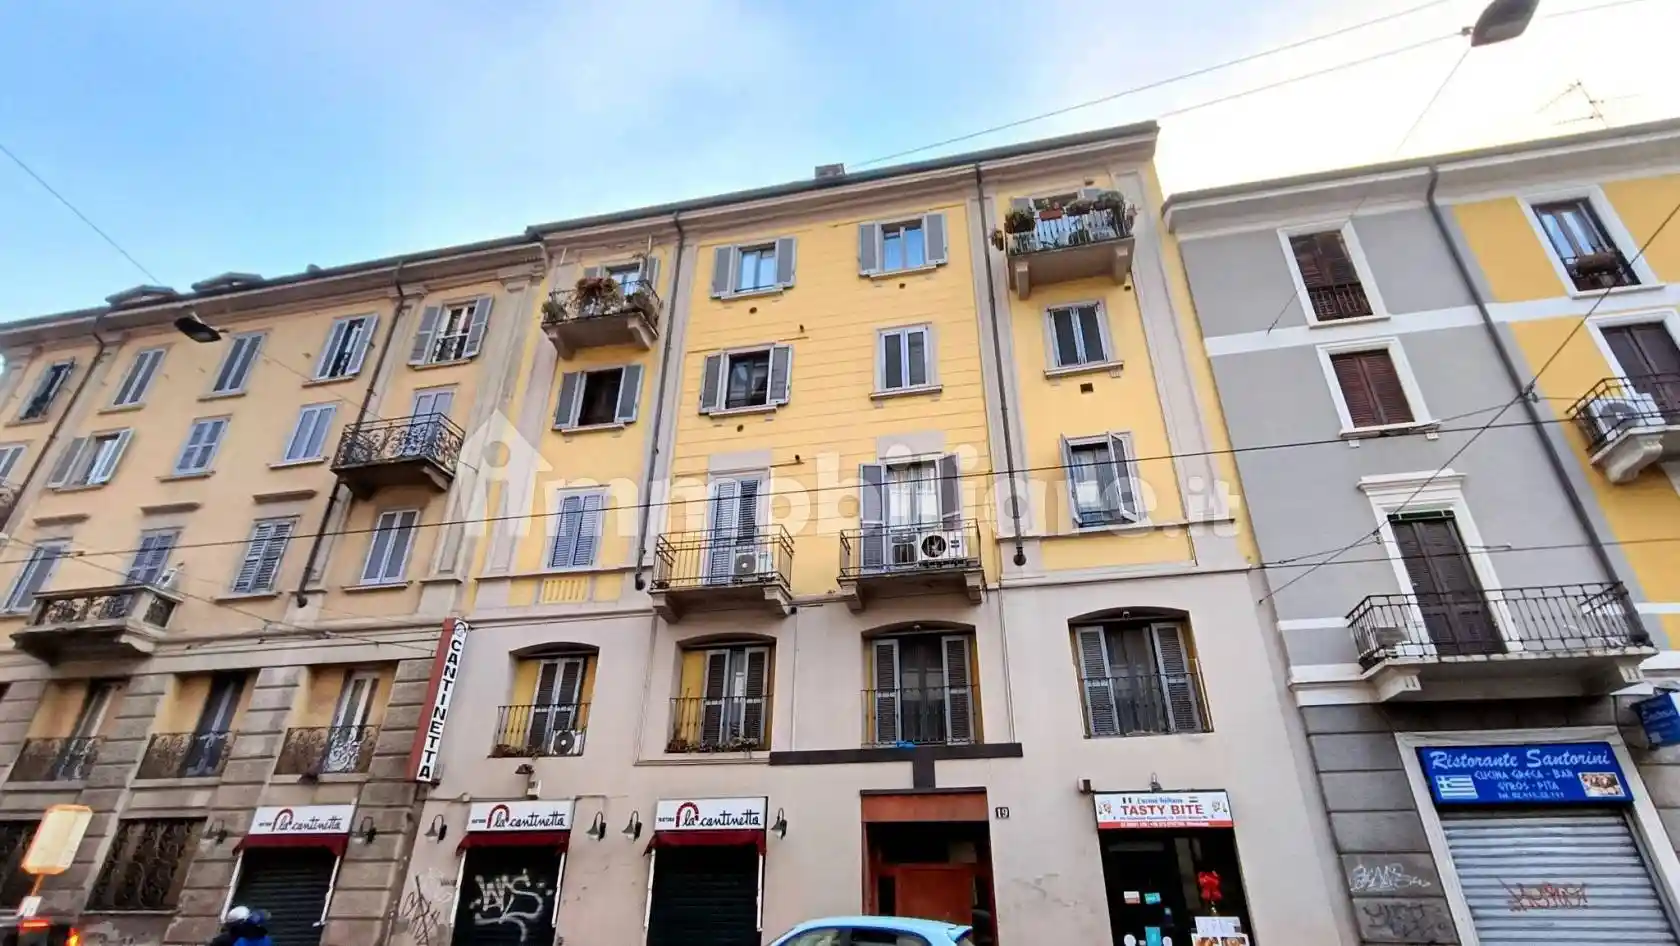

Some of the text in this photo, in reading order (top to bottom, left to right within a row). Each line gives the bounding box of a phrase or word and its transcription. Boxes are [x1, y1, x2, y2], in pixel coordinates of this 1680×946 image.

[419, 639, 462, 779] CANTINETTA
[1429, 749, 1610, 769] Ristorante Santorini
[1474, 769, 1509, 780] CUCINA
[1511, 768, 1544, 780] GRECA
[1552, 768, 1575, 779] BAR
[1537, 780, 1560, 790] PITA
[997, 808, 1008, 818] 19
[1121, 804, 1205, 816] TASTY BITE
[291, 815, 343, 830] cantinetta
[508, 810, 566, 827] cantinetta
[699, 809, 761, 827] cantinetta
